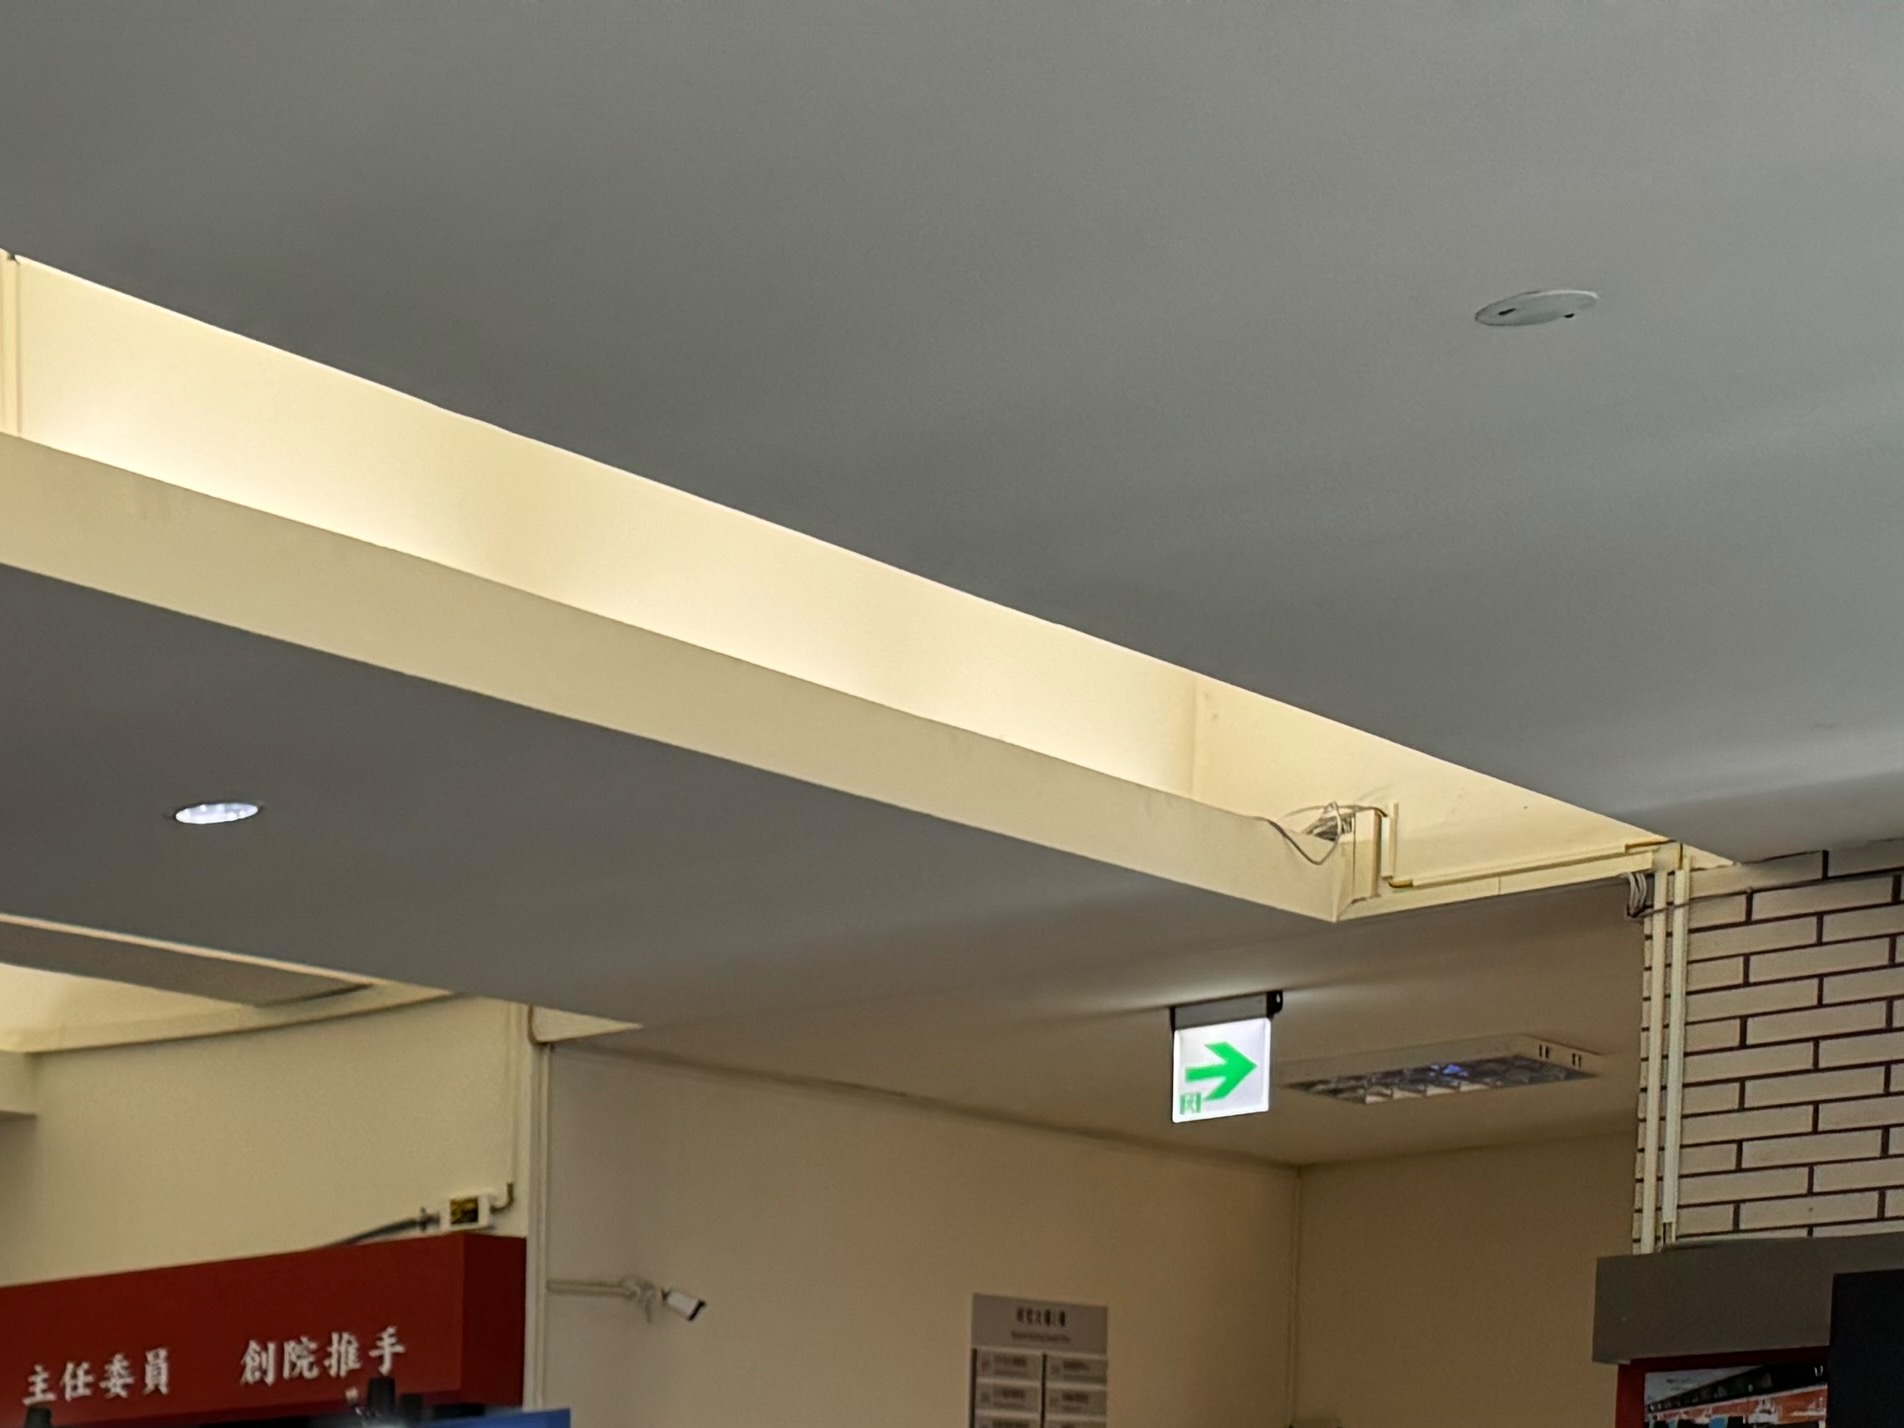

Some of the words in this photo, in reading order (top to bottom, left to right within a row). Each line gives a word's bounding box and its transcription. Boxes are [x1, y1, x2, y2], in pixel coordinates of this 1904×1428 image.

[21, 1346, 172, 1406] 主任委員
[239, 1325, 407, 1387] 創院推手
